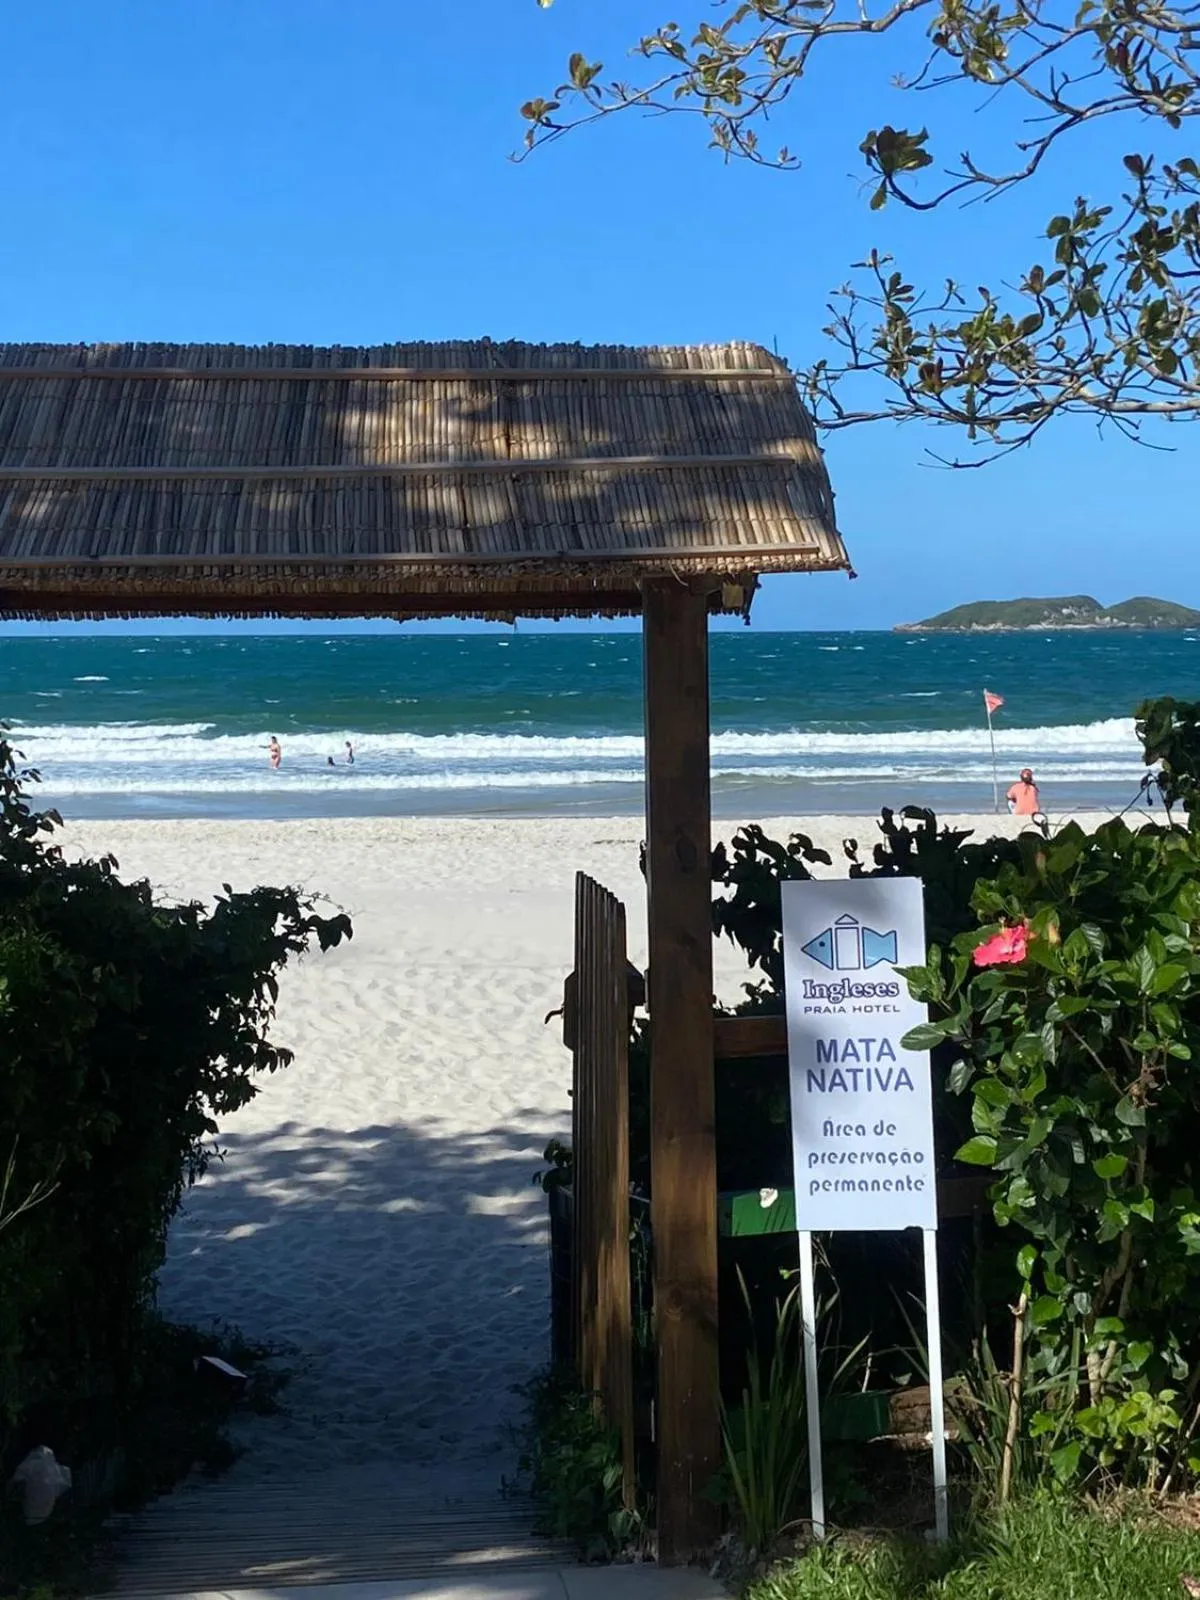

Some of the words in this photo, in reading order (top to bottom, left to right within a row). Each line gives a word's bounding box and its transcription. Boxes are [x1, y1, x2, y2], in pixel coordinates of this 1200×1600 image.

[802, 977, 900, 1004] Ingleses
[804, 1005, 847, 1014] PRAIA
[852, 1004, 900, 1013] HOTEL
[816, 1037, 897, 1064] MATA
[806, 1067, 914, 1093] NATIVA
[873, 1119, 897, 1137] de
[808, 1148, 925, 1169] preservação
[809, 1175, 926, 1197] permanente
